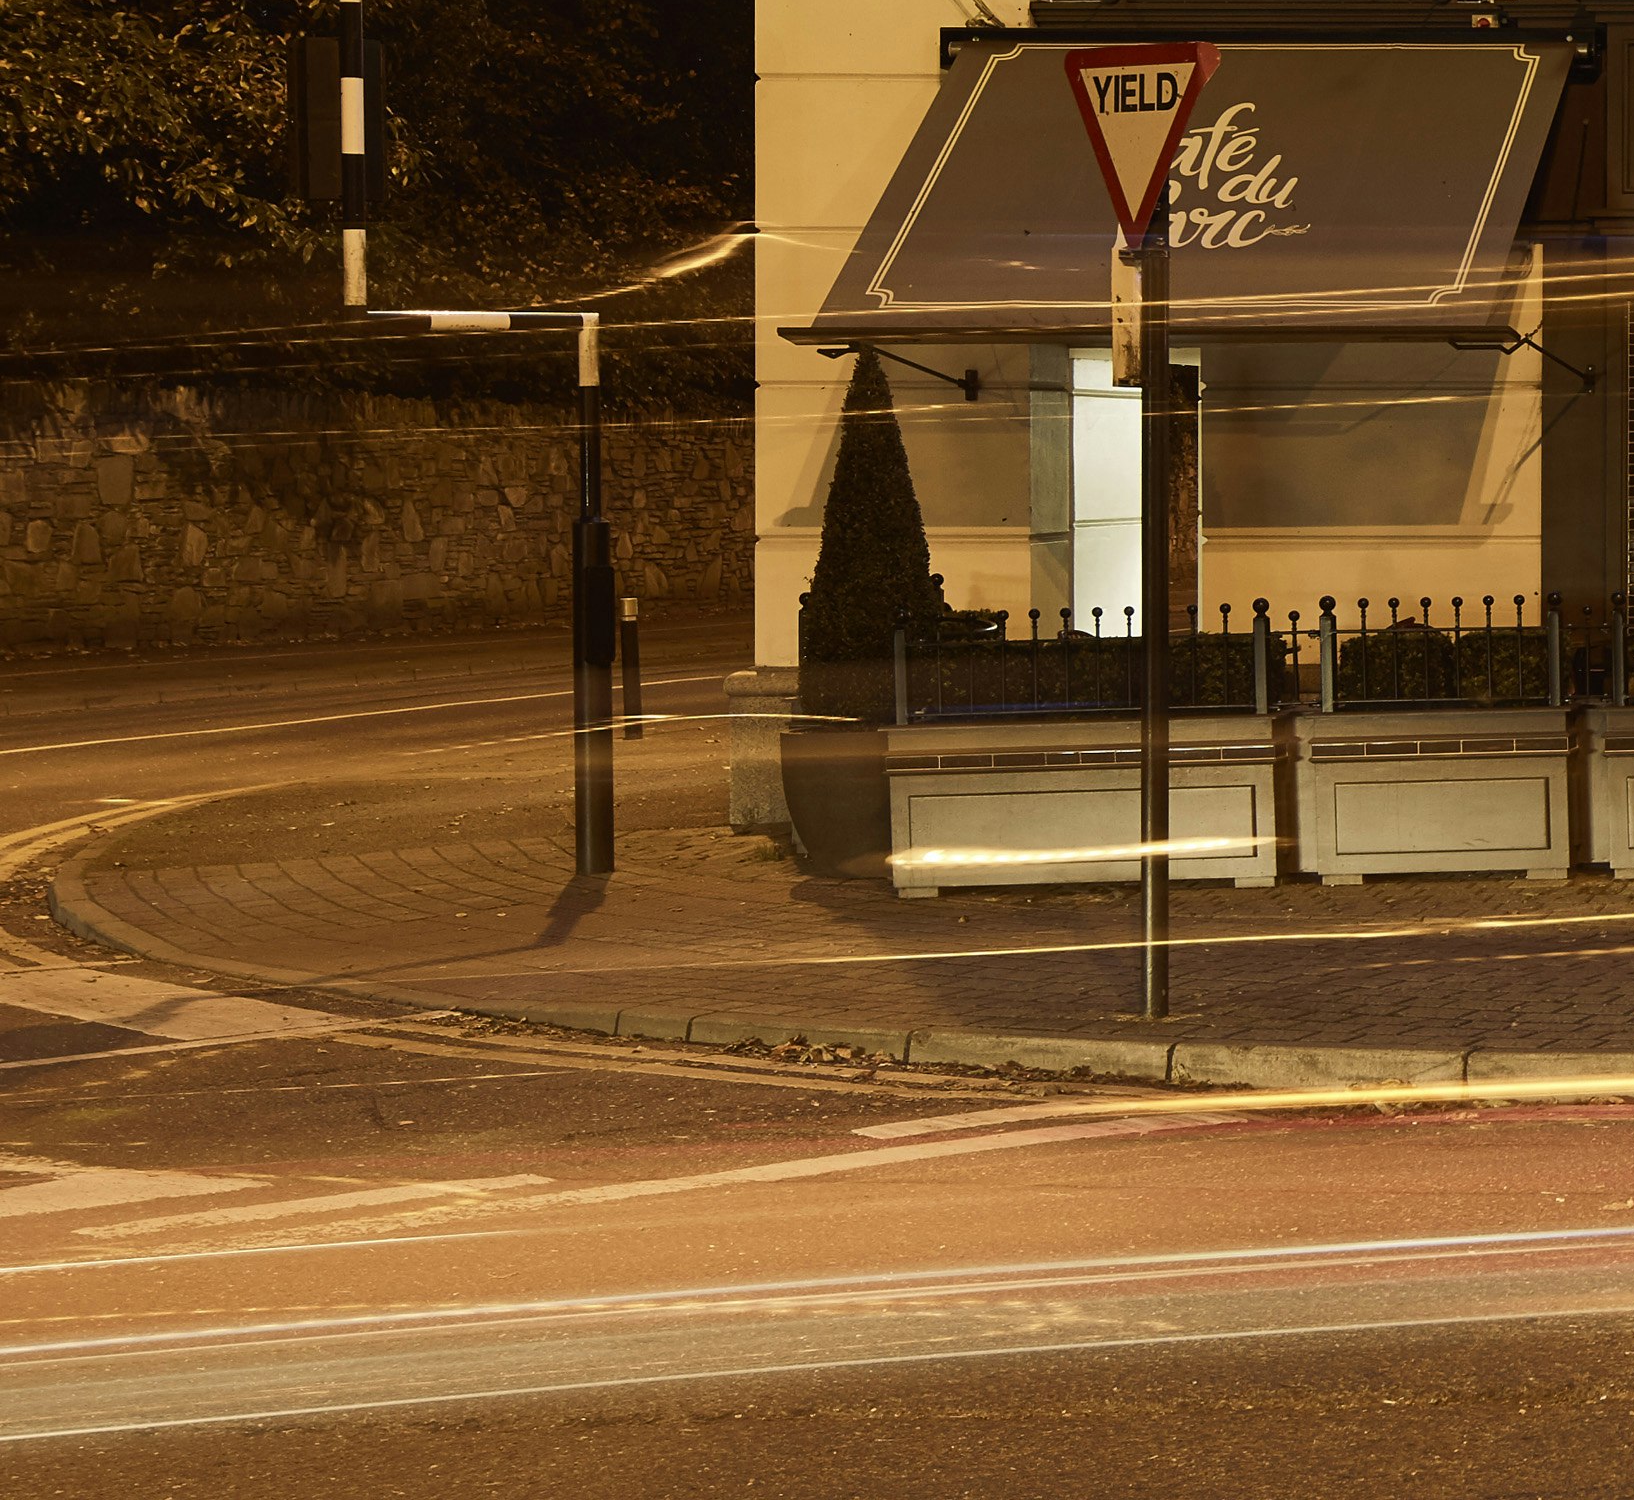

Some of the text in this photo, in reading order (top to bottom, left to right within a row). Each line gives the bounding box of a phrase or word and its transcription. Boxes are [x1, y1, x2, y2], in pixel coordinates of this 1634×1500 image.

[1093, 71, 1179, 115] YIELD
[1169, 102, 1260, 190] afé
[1217, 154, 1299, 209] du
